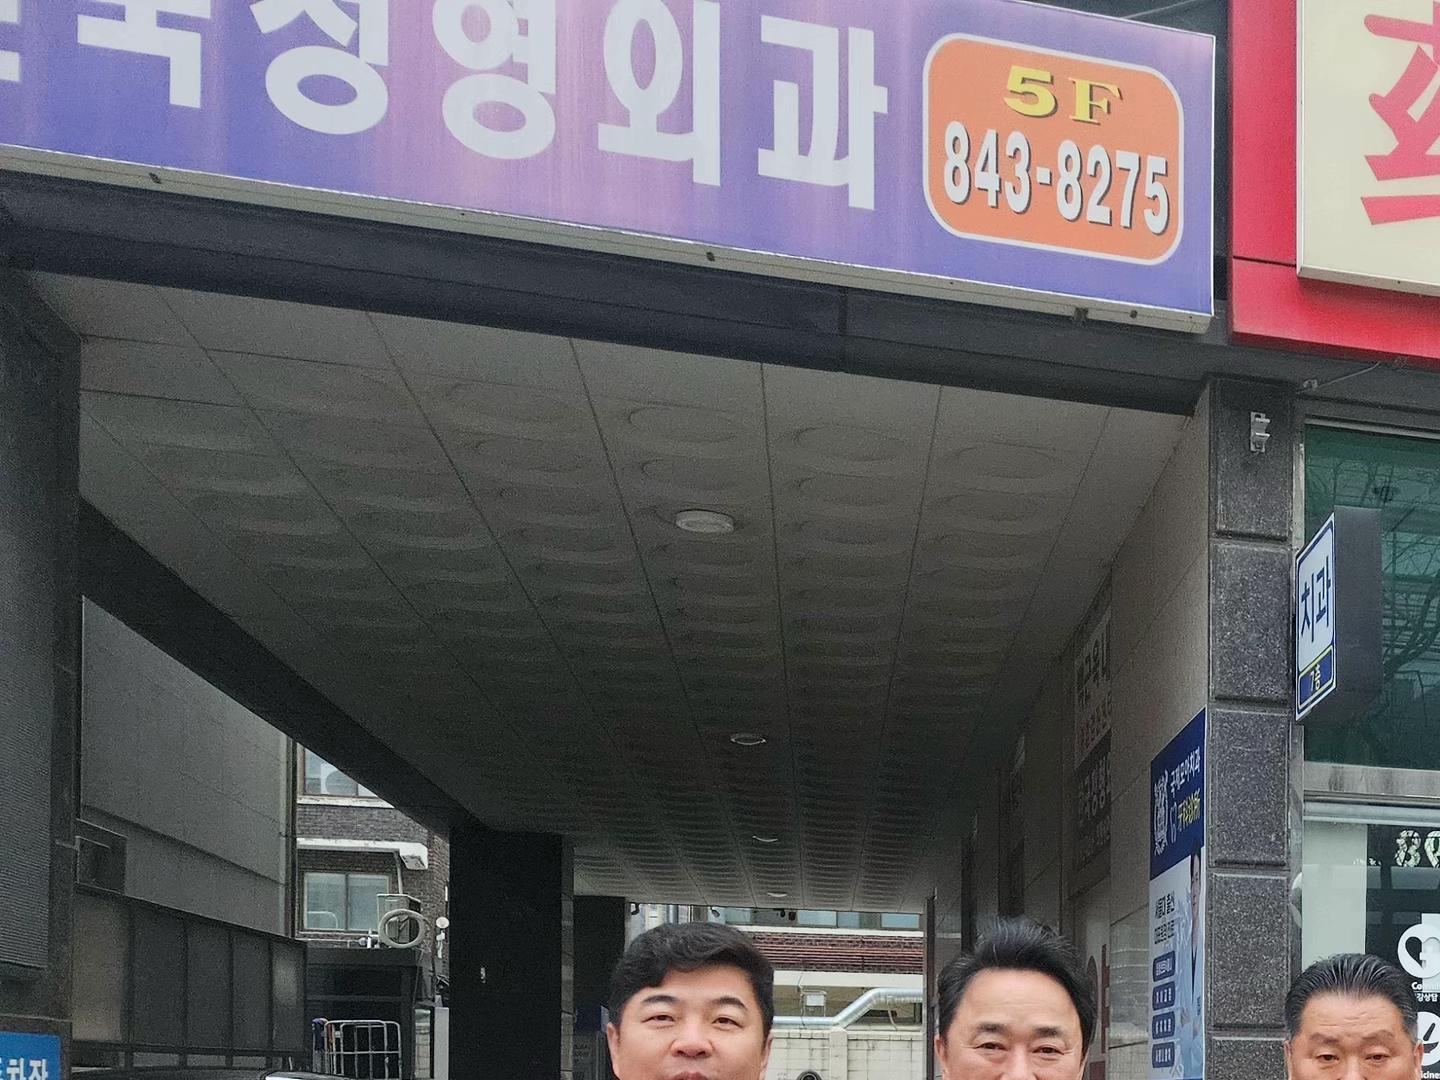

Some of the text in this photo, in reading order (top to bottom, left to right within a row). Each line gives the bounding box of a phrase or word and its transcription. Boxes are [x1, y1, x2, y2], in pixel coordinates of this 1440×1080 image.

[943, 120, 1171, 236] 843-8275
[1301, 556, 1332, 643] 치과
[1414, 993, 1438, 1002] 강상담
